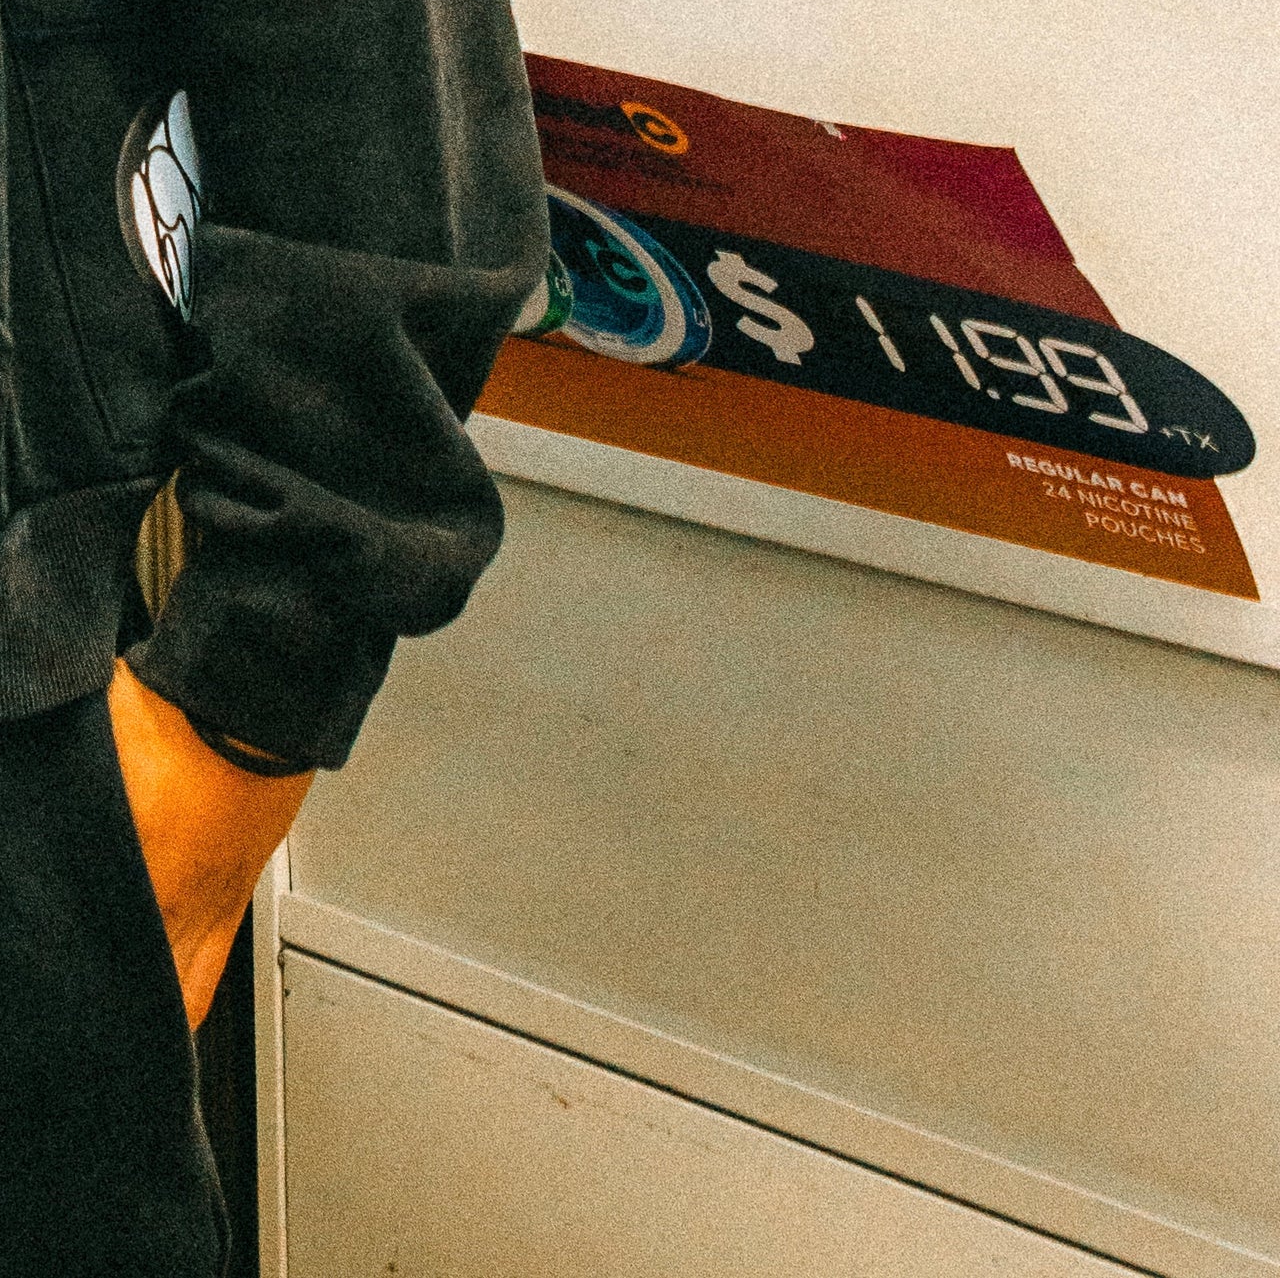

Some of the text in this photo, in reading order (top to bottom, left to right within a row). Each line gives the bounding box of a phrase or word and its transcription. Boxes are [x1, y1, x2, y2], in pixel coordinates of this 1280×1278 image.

[1005, 451, 1190, 510] REGULAR CAN
[1042, 481, 1197, 533] 24 NICOTINE
[1084, 510, 1208, 556] POUCHES
